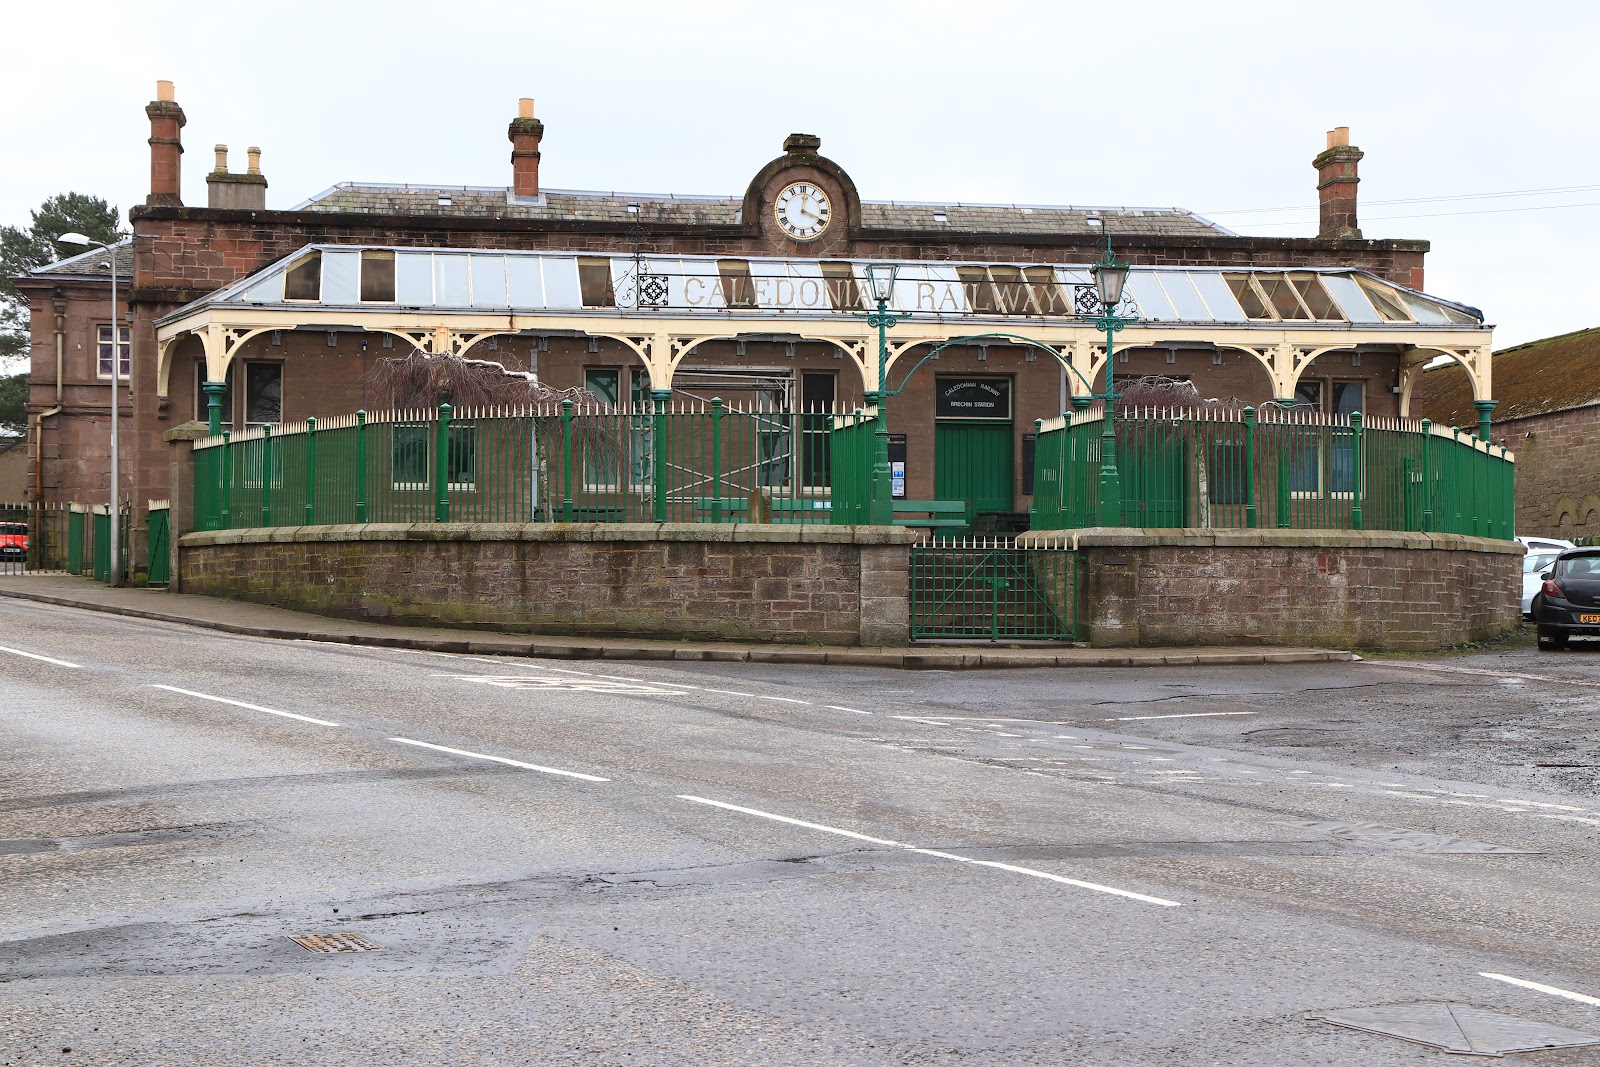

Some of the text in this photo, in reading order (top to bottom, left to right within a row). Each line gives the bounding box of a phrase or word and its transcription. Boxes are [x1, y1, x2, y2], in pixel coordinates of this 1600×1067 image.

[684, 277, 1060, 312] CALEDONIAN RAILWAY
[944, 382, 1000, 396] CALEDONIAN RAILWAY
